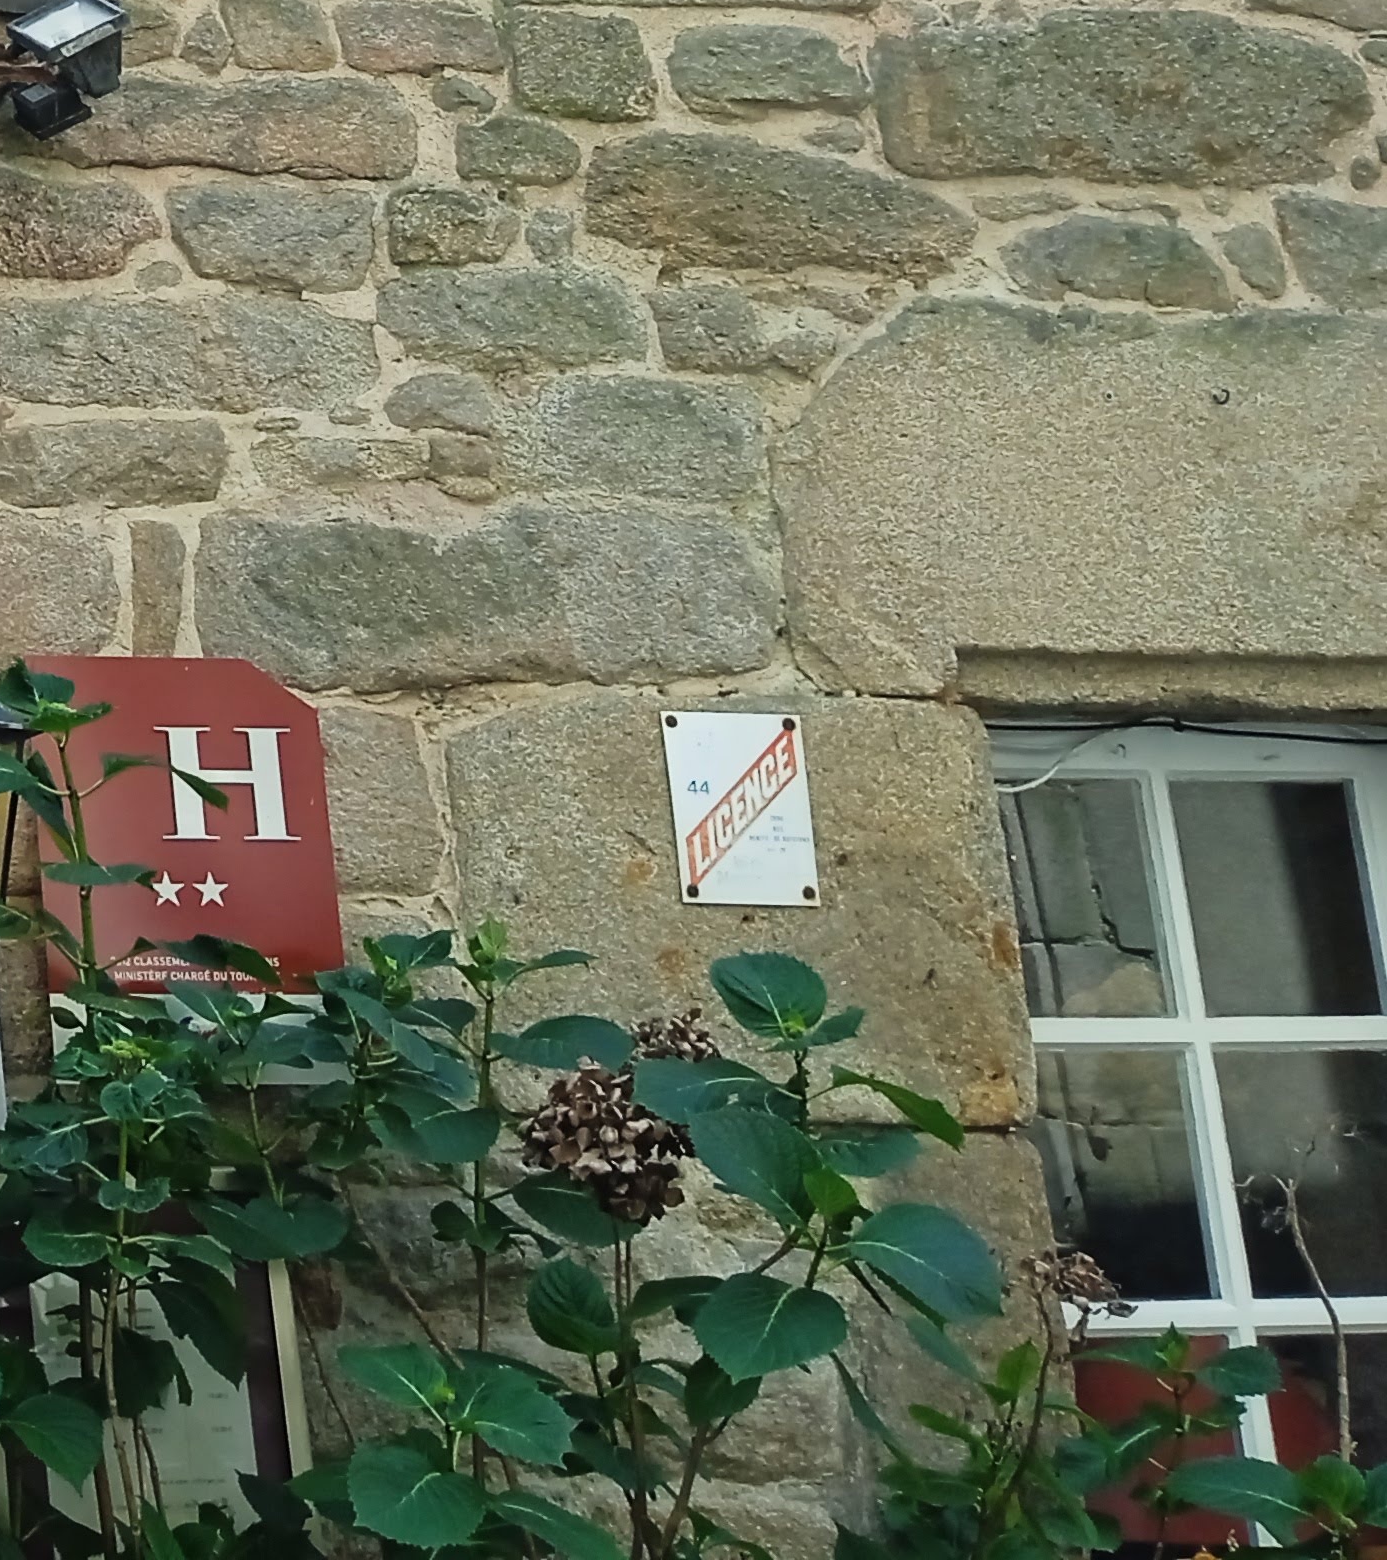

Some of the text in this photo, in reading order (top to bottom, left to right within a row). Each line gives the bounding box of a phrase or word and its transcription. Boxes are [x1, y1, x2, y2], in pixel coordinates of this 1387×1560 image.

[153, 726, 302, 841] H
[691, 734, 796, 878] LICENCE
[170, 969, 212, 982] CHARGÉ
[213, 971, 228, 982] DU
